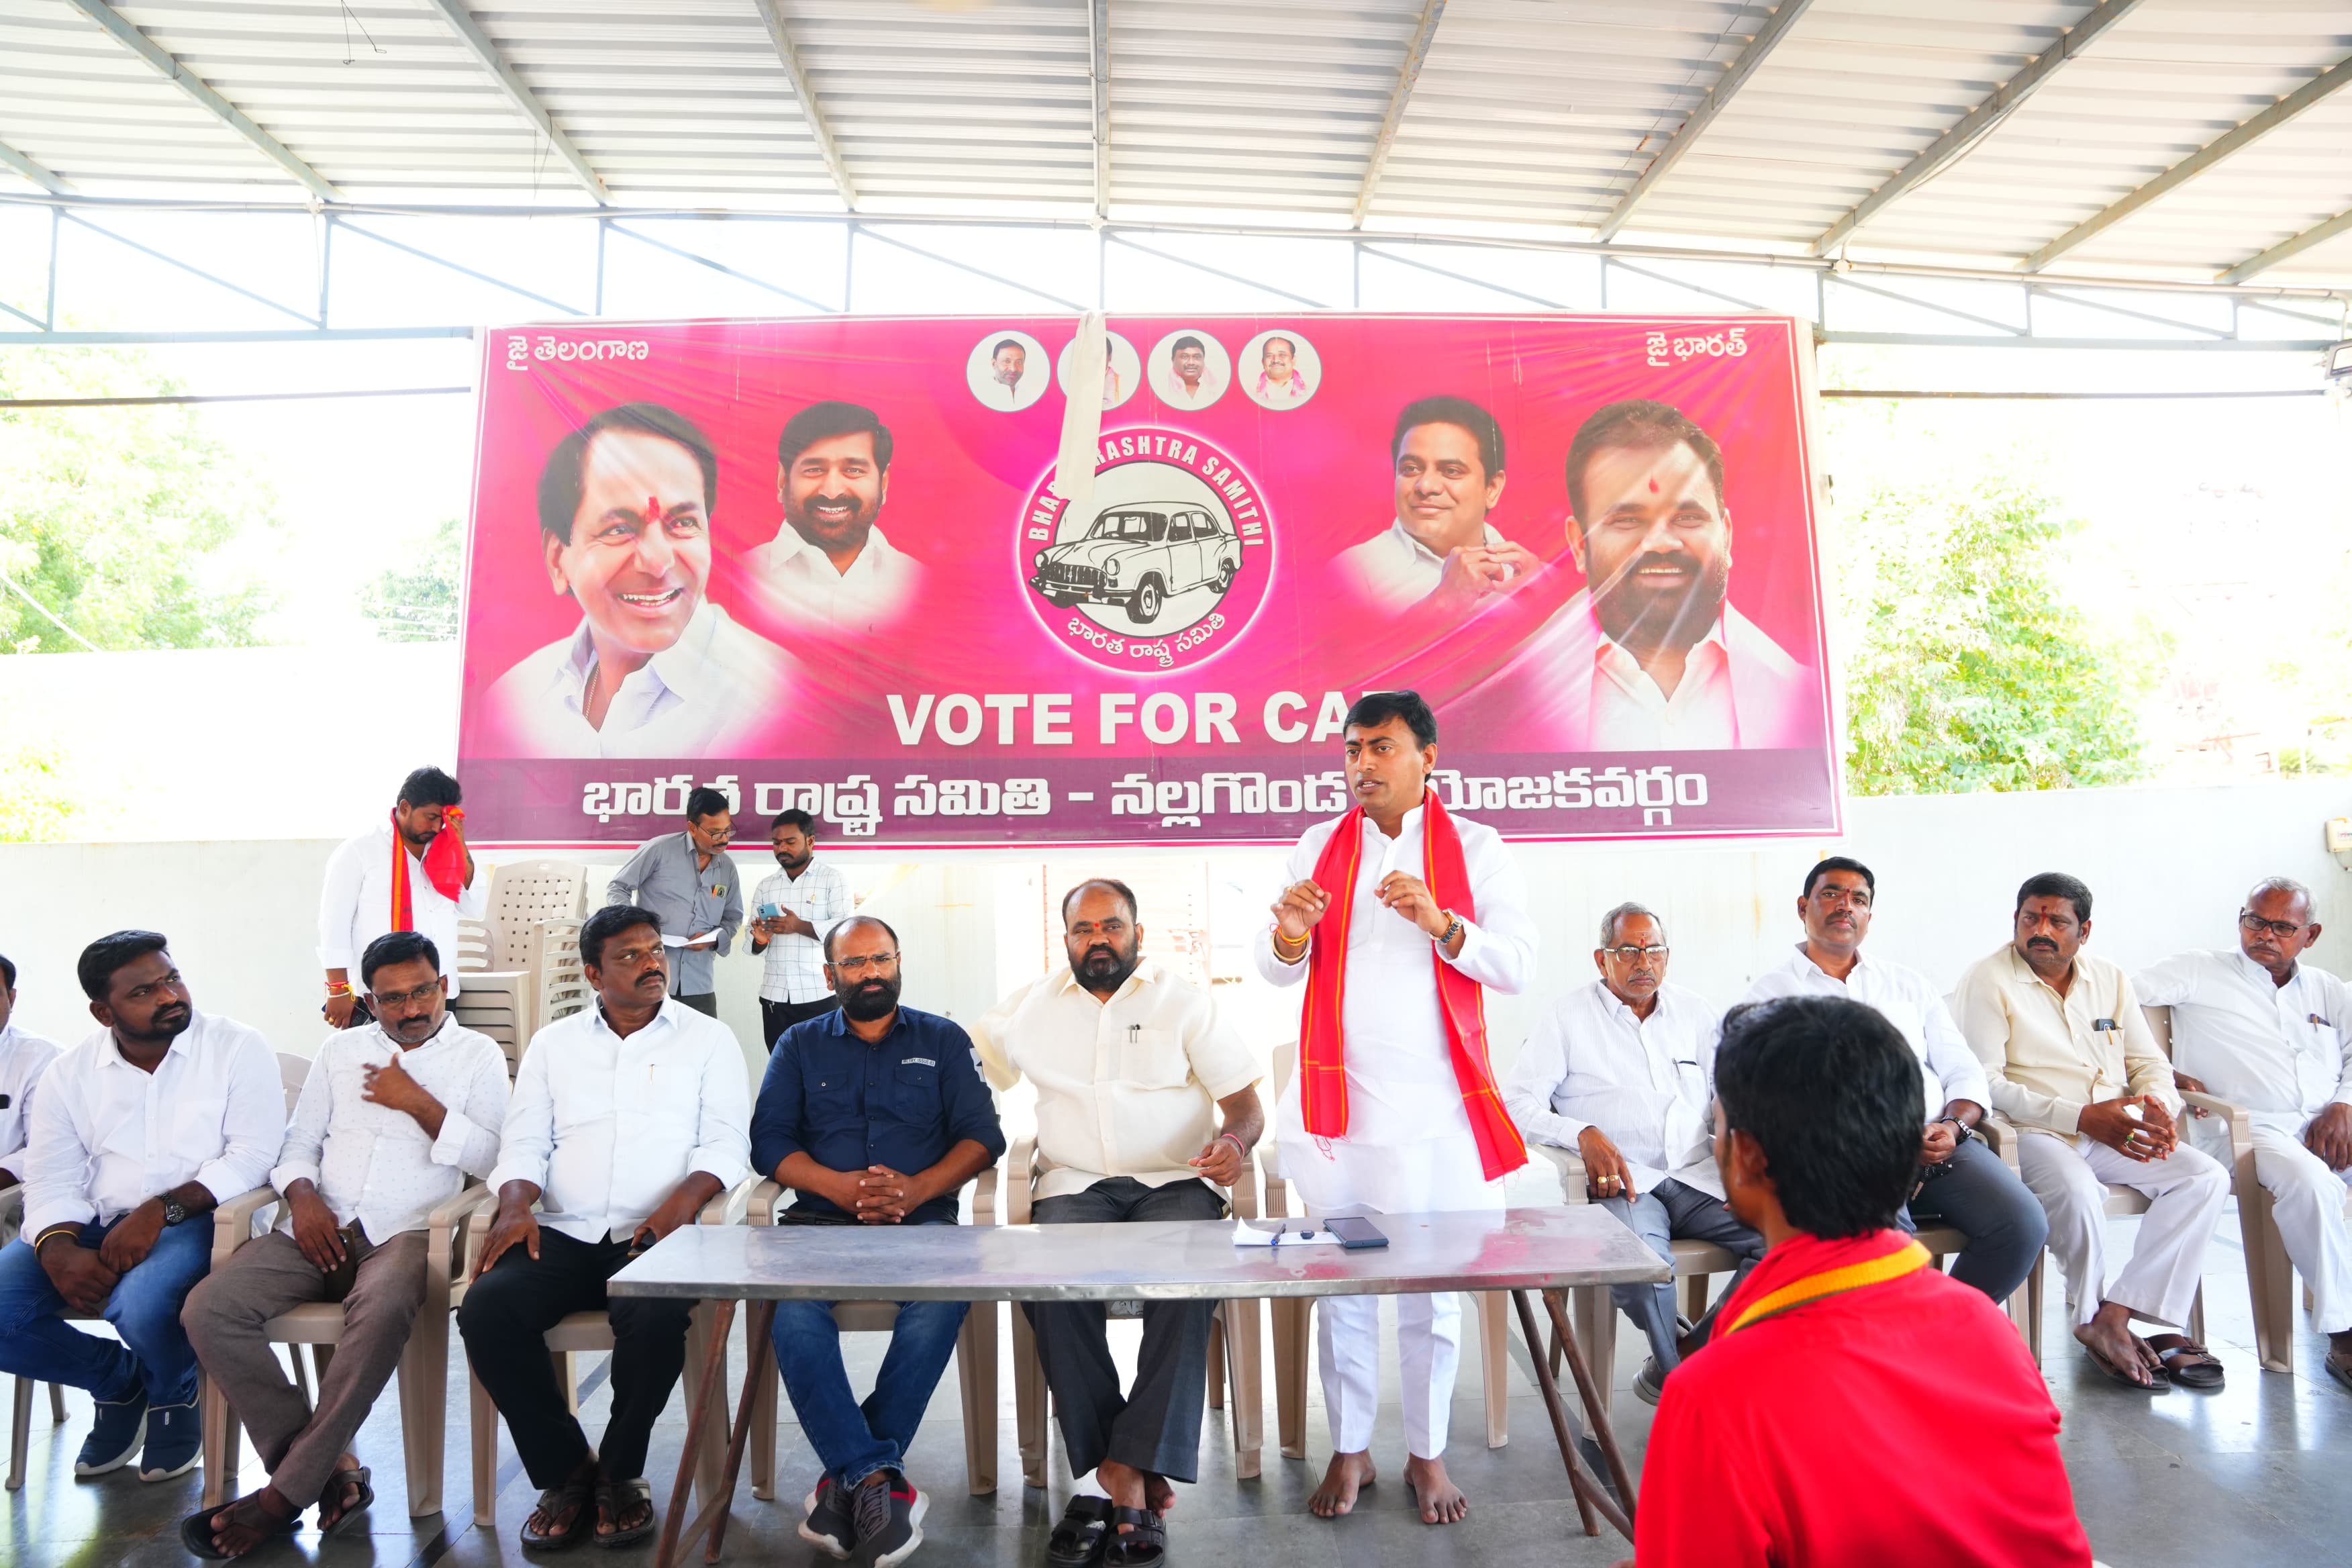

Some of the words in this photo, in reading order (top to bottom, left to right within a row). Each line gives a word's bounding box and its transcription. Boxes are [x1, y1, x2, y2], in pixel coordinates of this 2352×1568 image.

[506, 335, 529, 371] జై
[534, 335, 649, 361] తెలంగాణ
[1646, 332, 1670, 366] జై
[1673, 328, 1748, 362] భారత్
[1202, 456, 1264, 546] SAMITHI
[1067, 618, 1125, 654] భారత
[1130, 639, 1174, 668] రాష్ట్ర
[1175, 613, 1226, 653] సమితి
[886, 693, 1073, 746] VOTE
[1099, 691, 1241, 745] FOR
[1263, 691, 1398, 743] CA
[895, 774, 1052, 817] సమితి
[1111, 771, 1348, 827] నల్లగొండ
[1428, 766, 1708, 826] యోజకవర్గం
